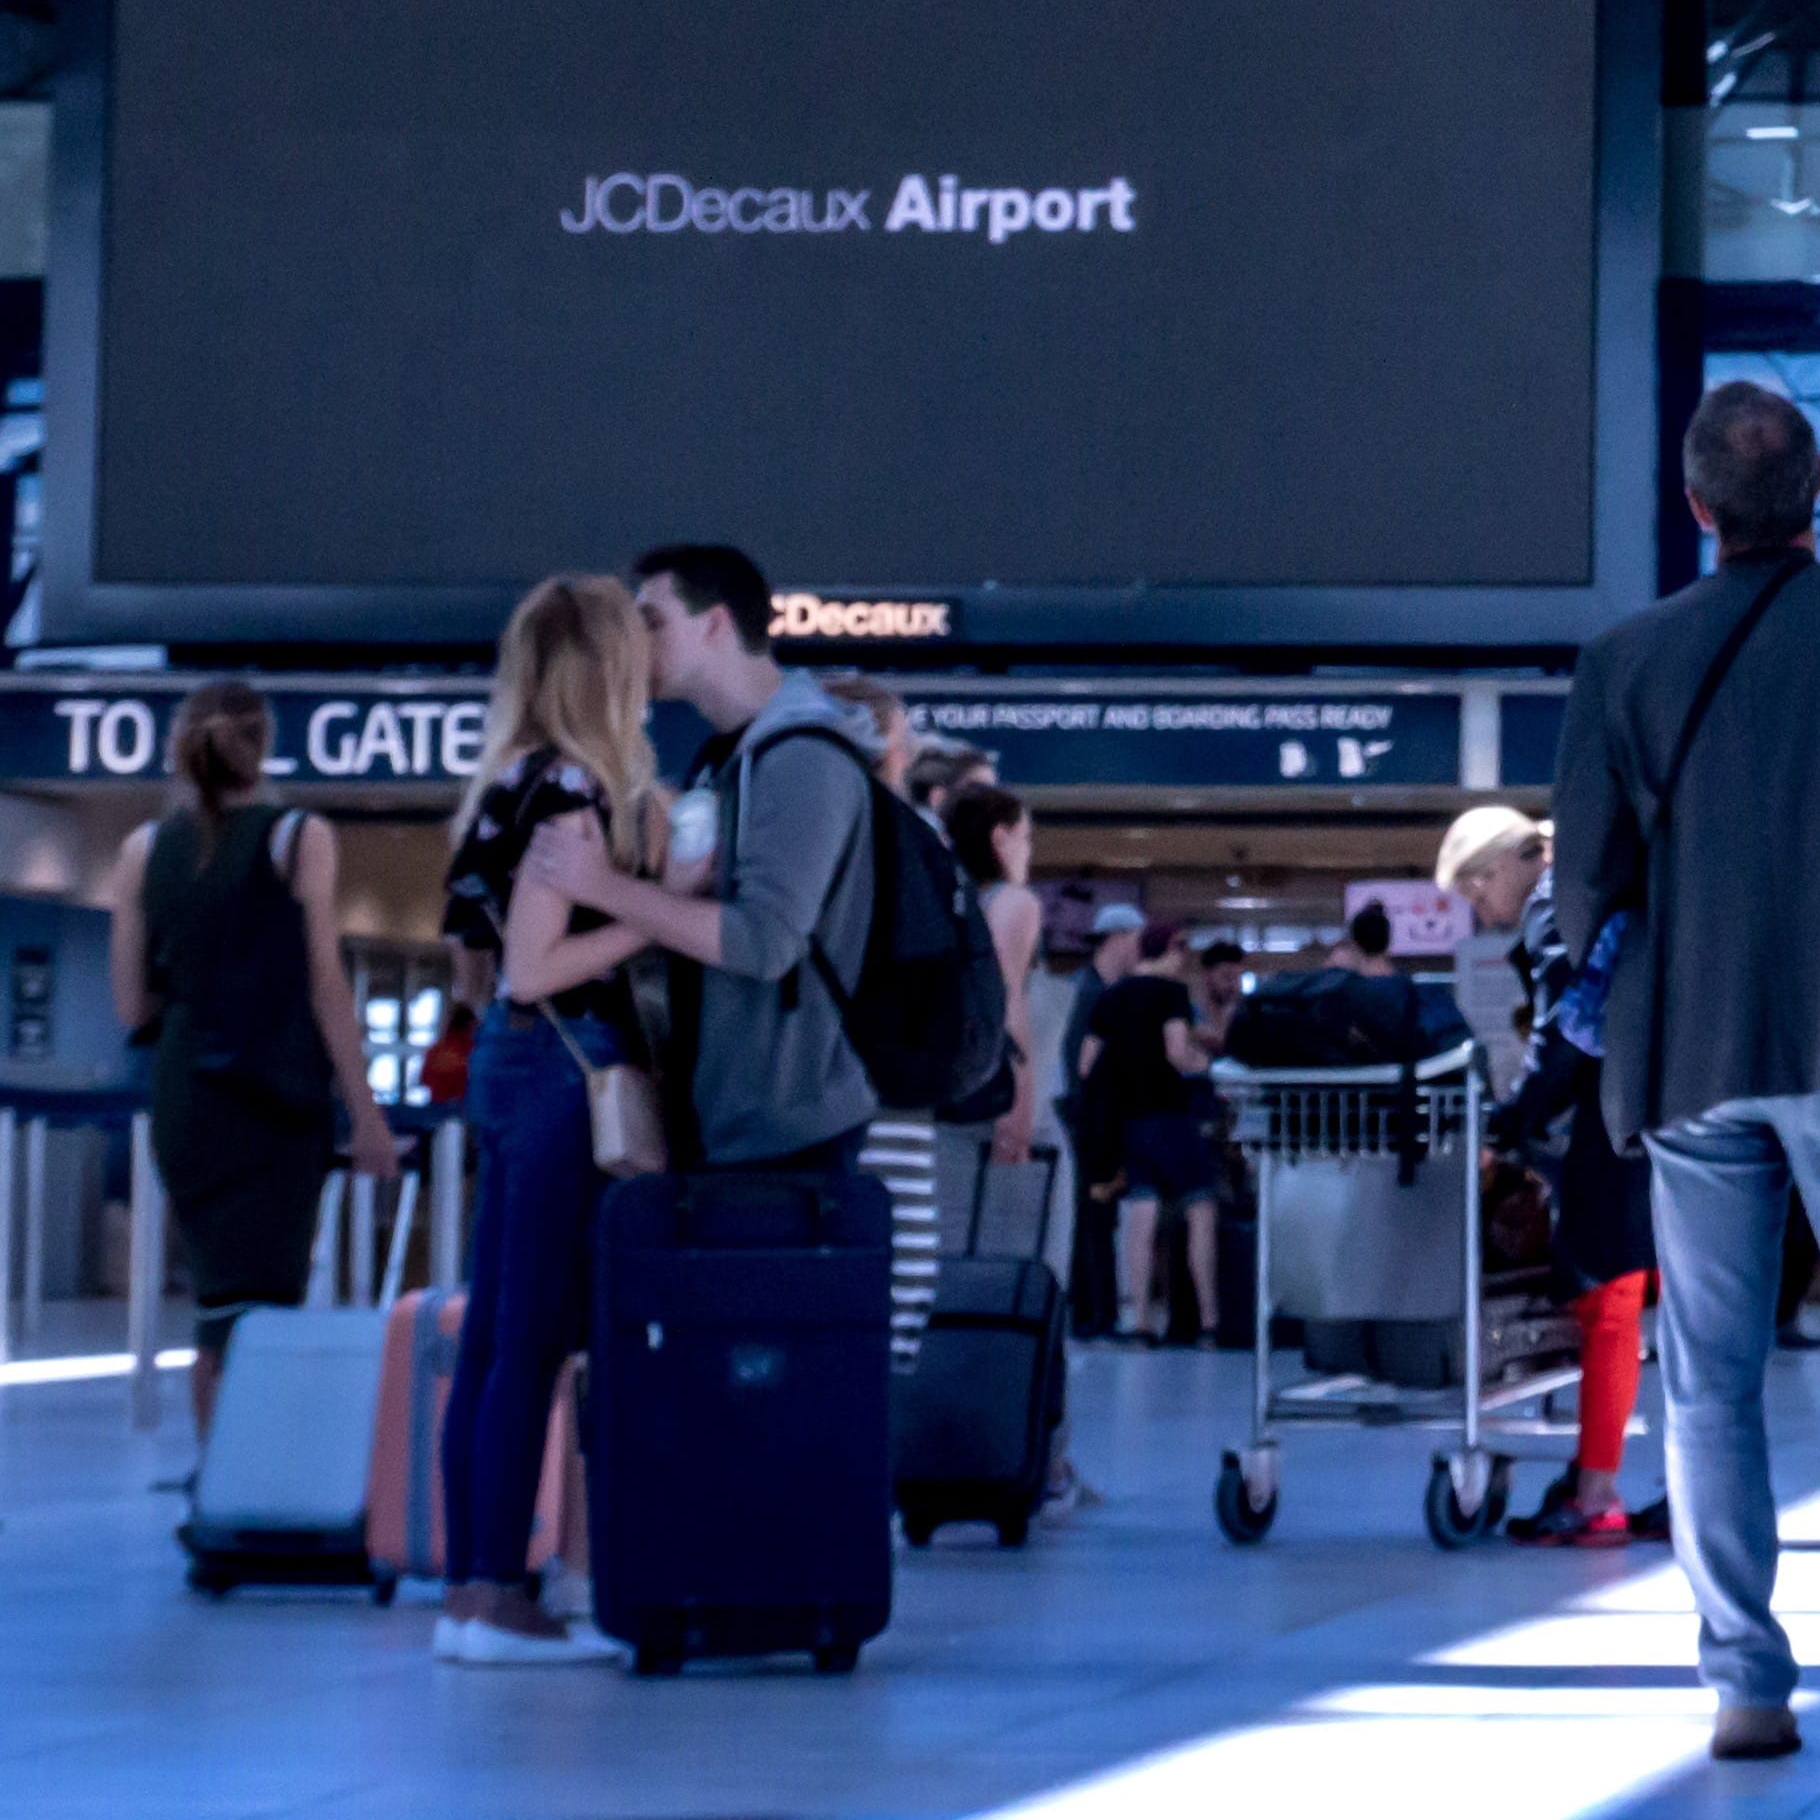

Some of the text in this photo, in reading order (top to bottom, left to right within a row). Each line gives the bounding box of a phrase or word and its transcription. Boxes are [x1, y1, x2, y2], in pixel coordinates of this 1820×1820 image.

[559, 173, 1136, 245] JCDecaux Airport
[54, 700, 155, 774] TO
[932, 703, 991, 729] YOUR
[992, 703, 1100, 729] PASSPORT
[1103, 704, 1150, 729] AND
[1152, 703, 1262, 729] BOARDING
[1264, 703, 1319, 729] PASS
[1320, 703, 1393, 729] READY
